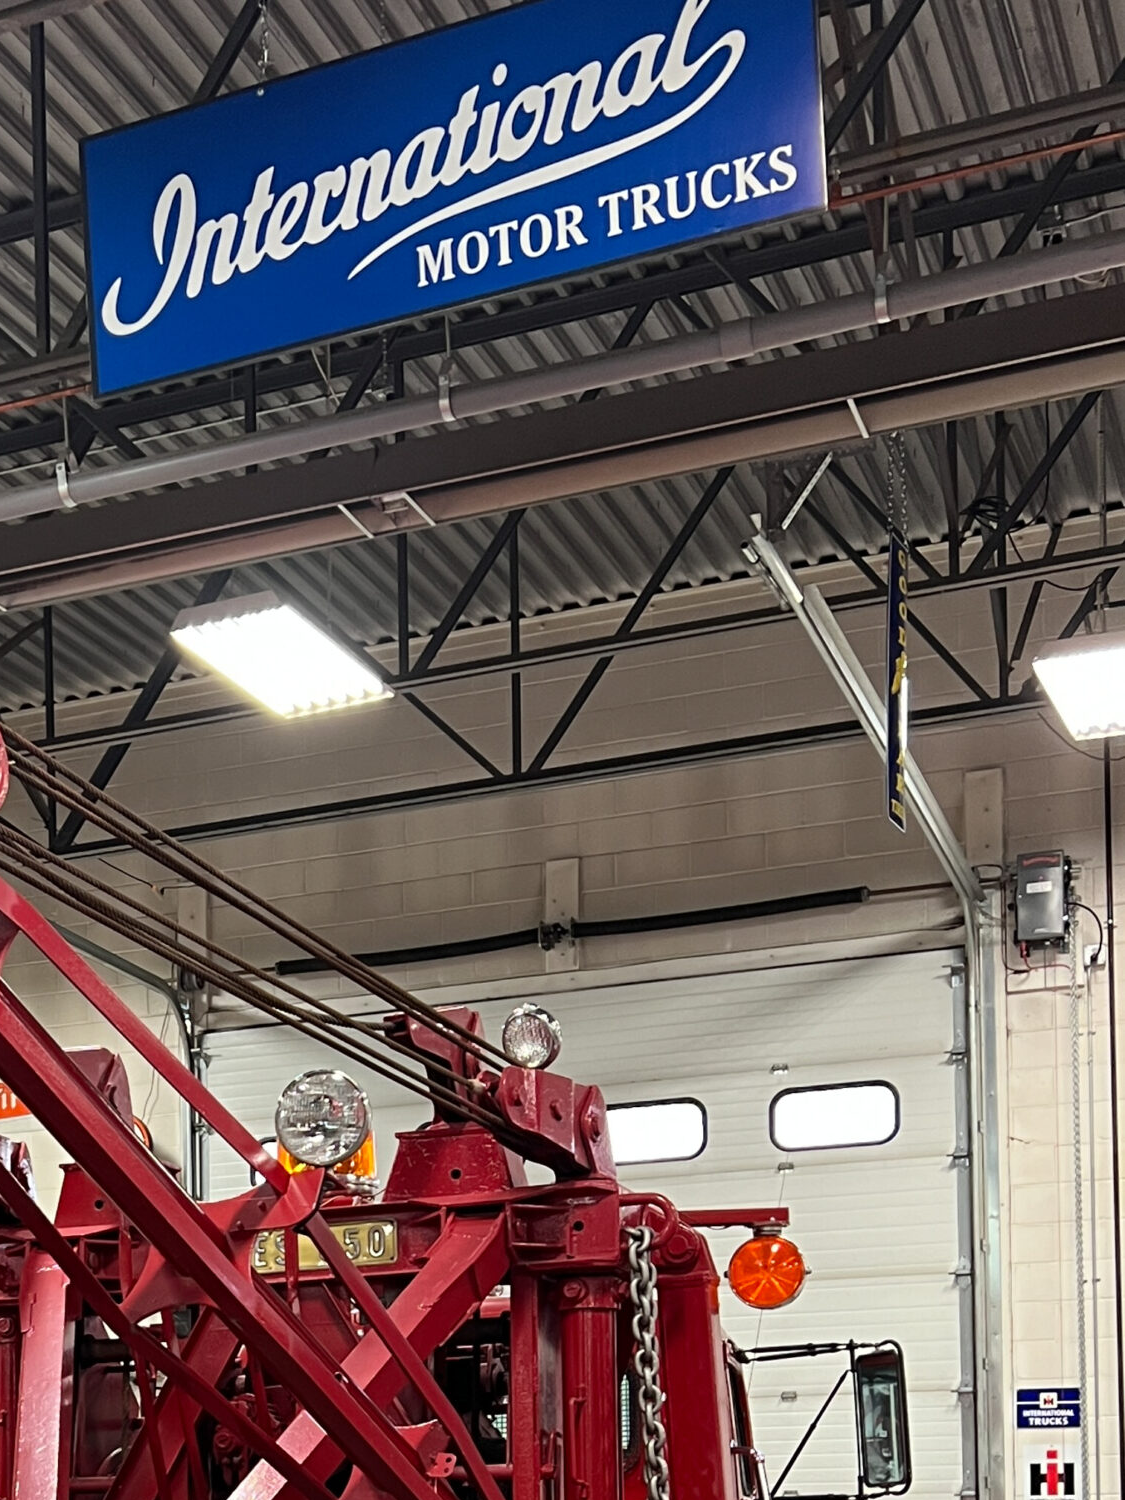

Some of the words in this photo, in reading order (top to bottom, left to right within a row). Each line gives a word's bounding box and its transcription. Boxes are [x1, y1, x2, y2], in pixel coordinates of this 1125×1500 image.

[102, 0, 746, 337] International
[416, 207, 588, 288] MOTOR
[598, 144, 798, 239] TRUCKS
[1022, 1409, 1075, 1417] INTERNATIONAL
[1028, 1417, 1069, 1426] TRUCKS
